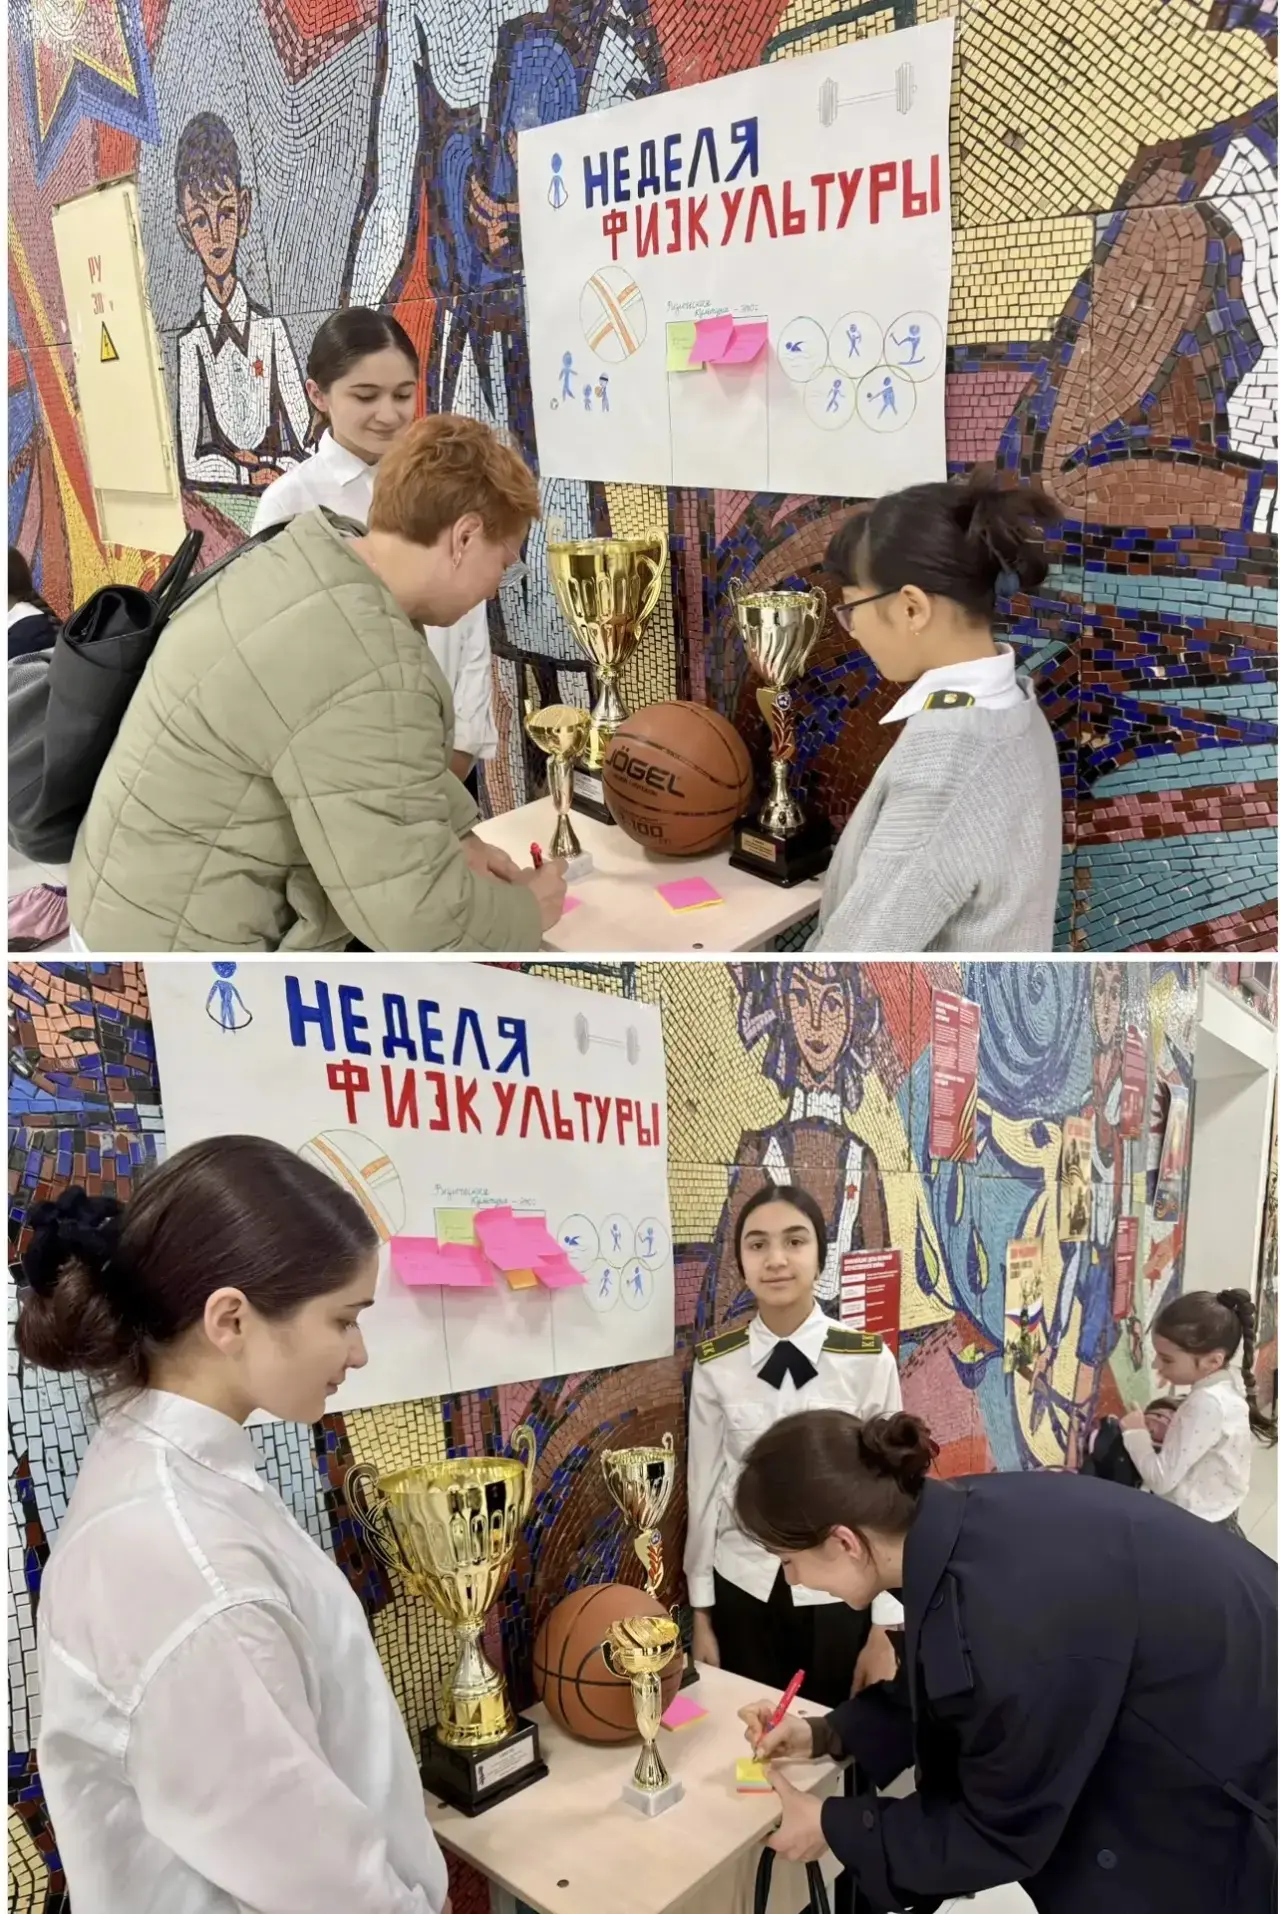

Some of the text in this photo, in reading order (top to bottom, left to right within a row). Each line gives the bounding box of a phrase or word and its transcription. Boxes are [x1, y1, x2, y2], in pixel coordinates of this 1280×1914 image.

[583, 116, 759, 209] НЕДЕЛЯ
[602, 154, 941, 261] ФИЗКУЛЬТУРЫ
[605, 745, 686, 798] JÖGEL
[284, 975, 532, 1078] НЕДЕЛЯ
[326, 1059, 661, 1147] ФИЗКУЛЬТУРЫ
